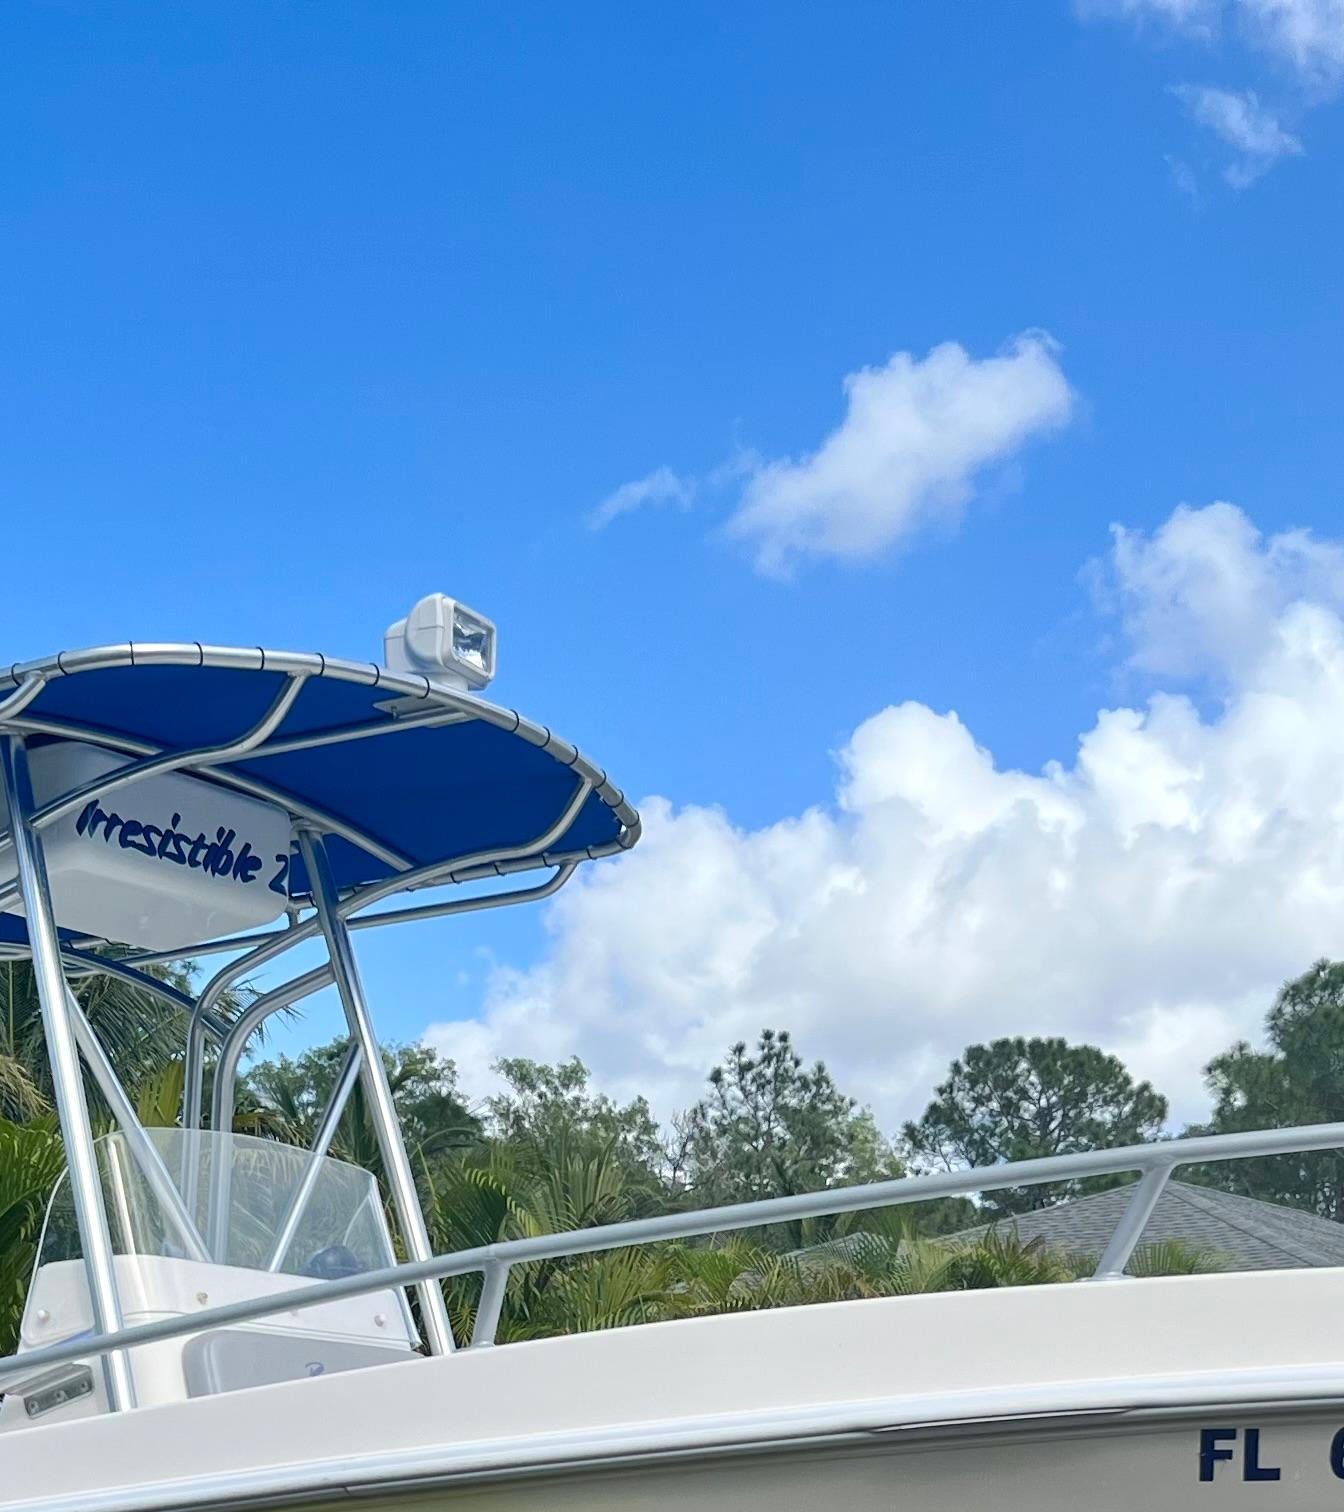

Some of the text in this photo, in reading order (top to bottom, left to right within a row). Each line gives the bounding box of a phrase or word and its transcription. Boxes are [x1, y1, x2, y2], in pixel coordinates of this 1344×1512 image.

[76, 799, 289, 896] Irresistible 2
[1198, 1427, 1281, 1482] FL
